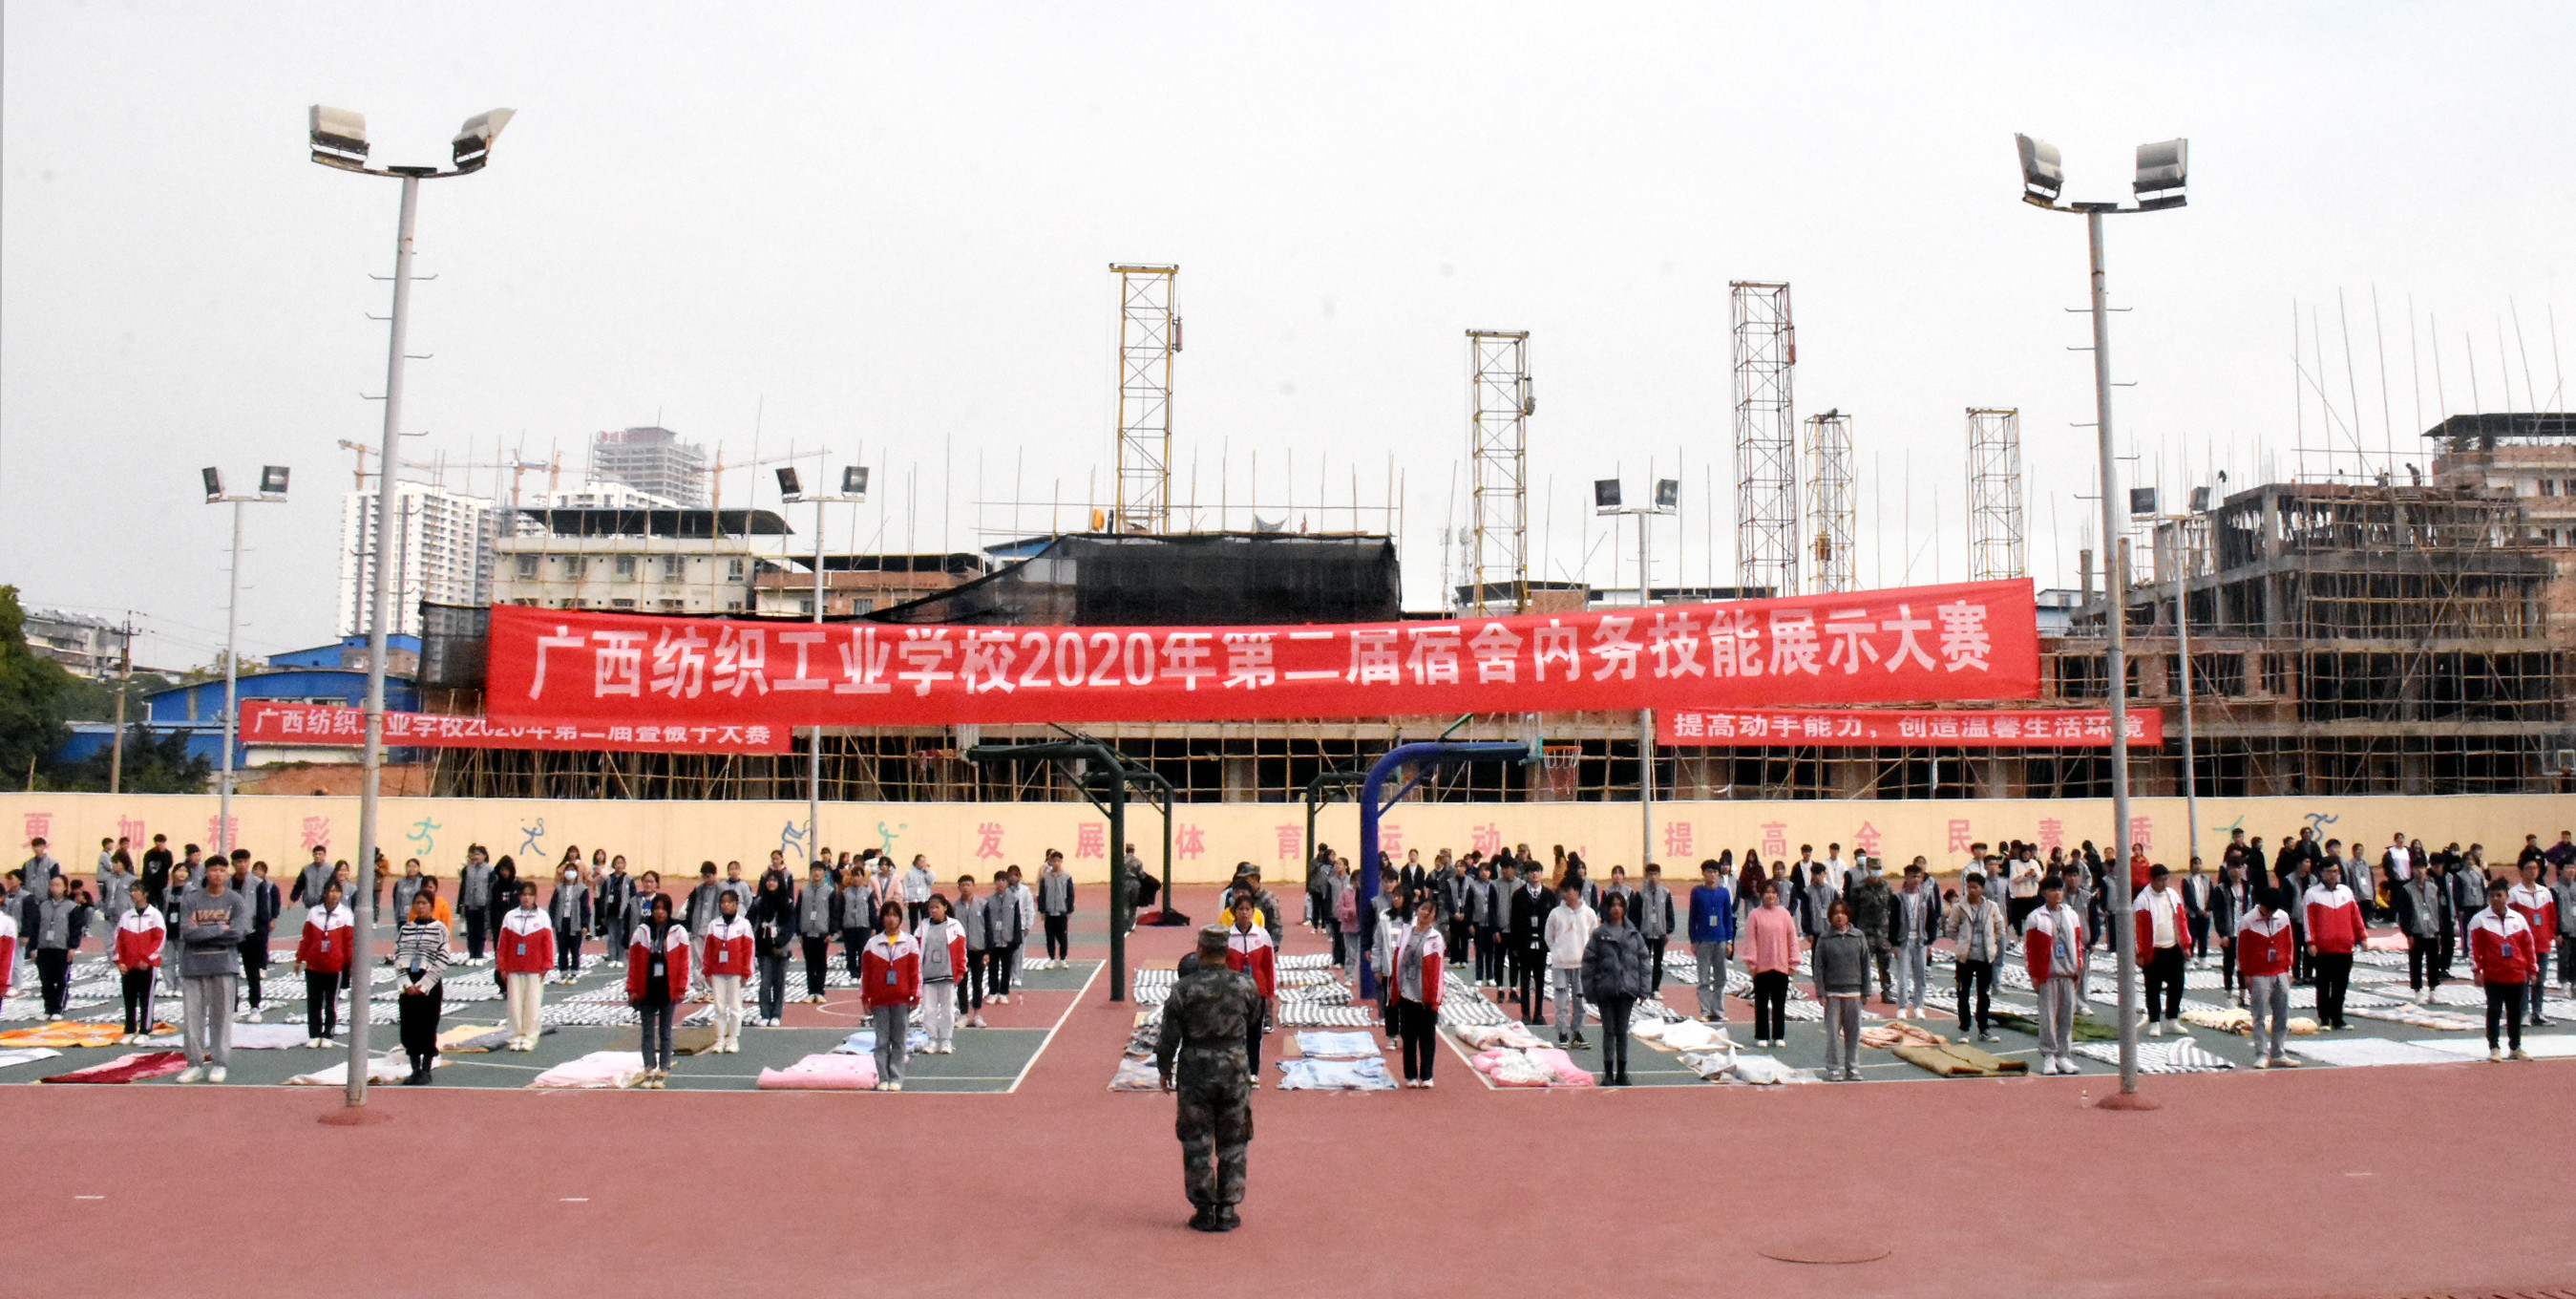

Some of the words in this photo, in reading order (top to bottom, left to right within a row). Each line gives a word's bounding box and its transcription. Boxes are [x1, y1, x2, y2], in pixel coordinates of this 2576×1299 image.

[529, 600, 1993, 700] 广西纺织工业学校2020年第二届宿舍内务技能展示大赛
[1673, 713, 2145, 739] 提高动手能力，创造温馨生活环境
